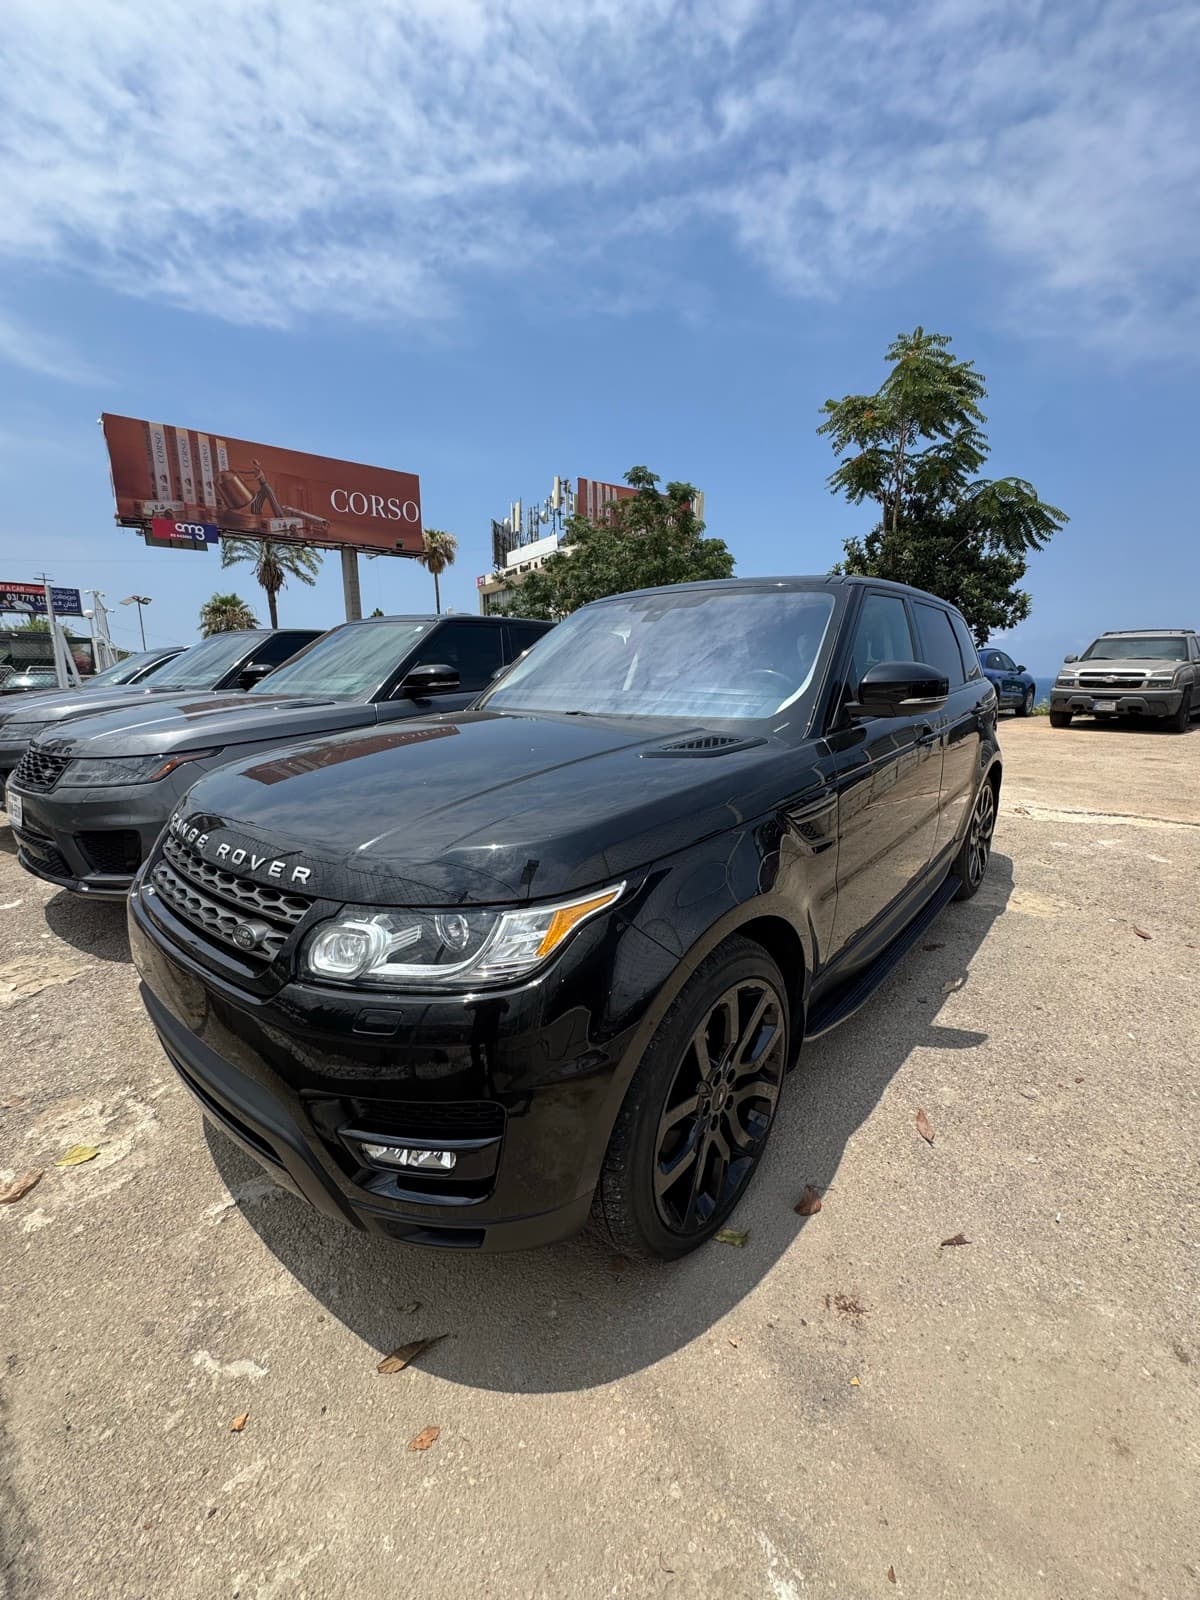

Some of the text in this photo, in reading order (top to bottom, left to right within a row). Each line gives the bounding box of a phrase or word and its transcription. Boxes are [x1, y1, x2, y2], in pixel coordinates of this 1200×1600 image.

[155, 432, 165, 464] CORSO
[330, 488, 420, 523] CORSO
[174, 522, 206, 541] amg
[171, 812, 312, 885] RANGE ROVER
